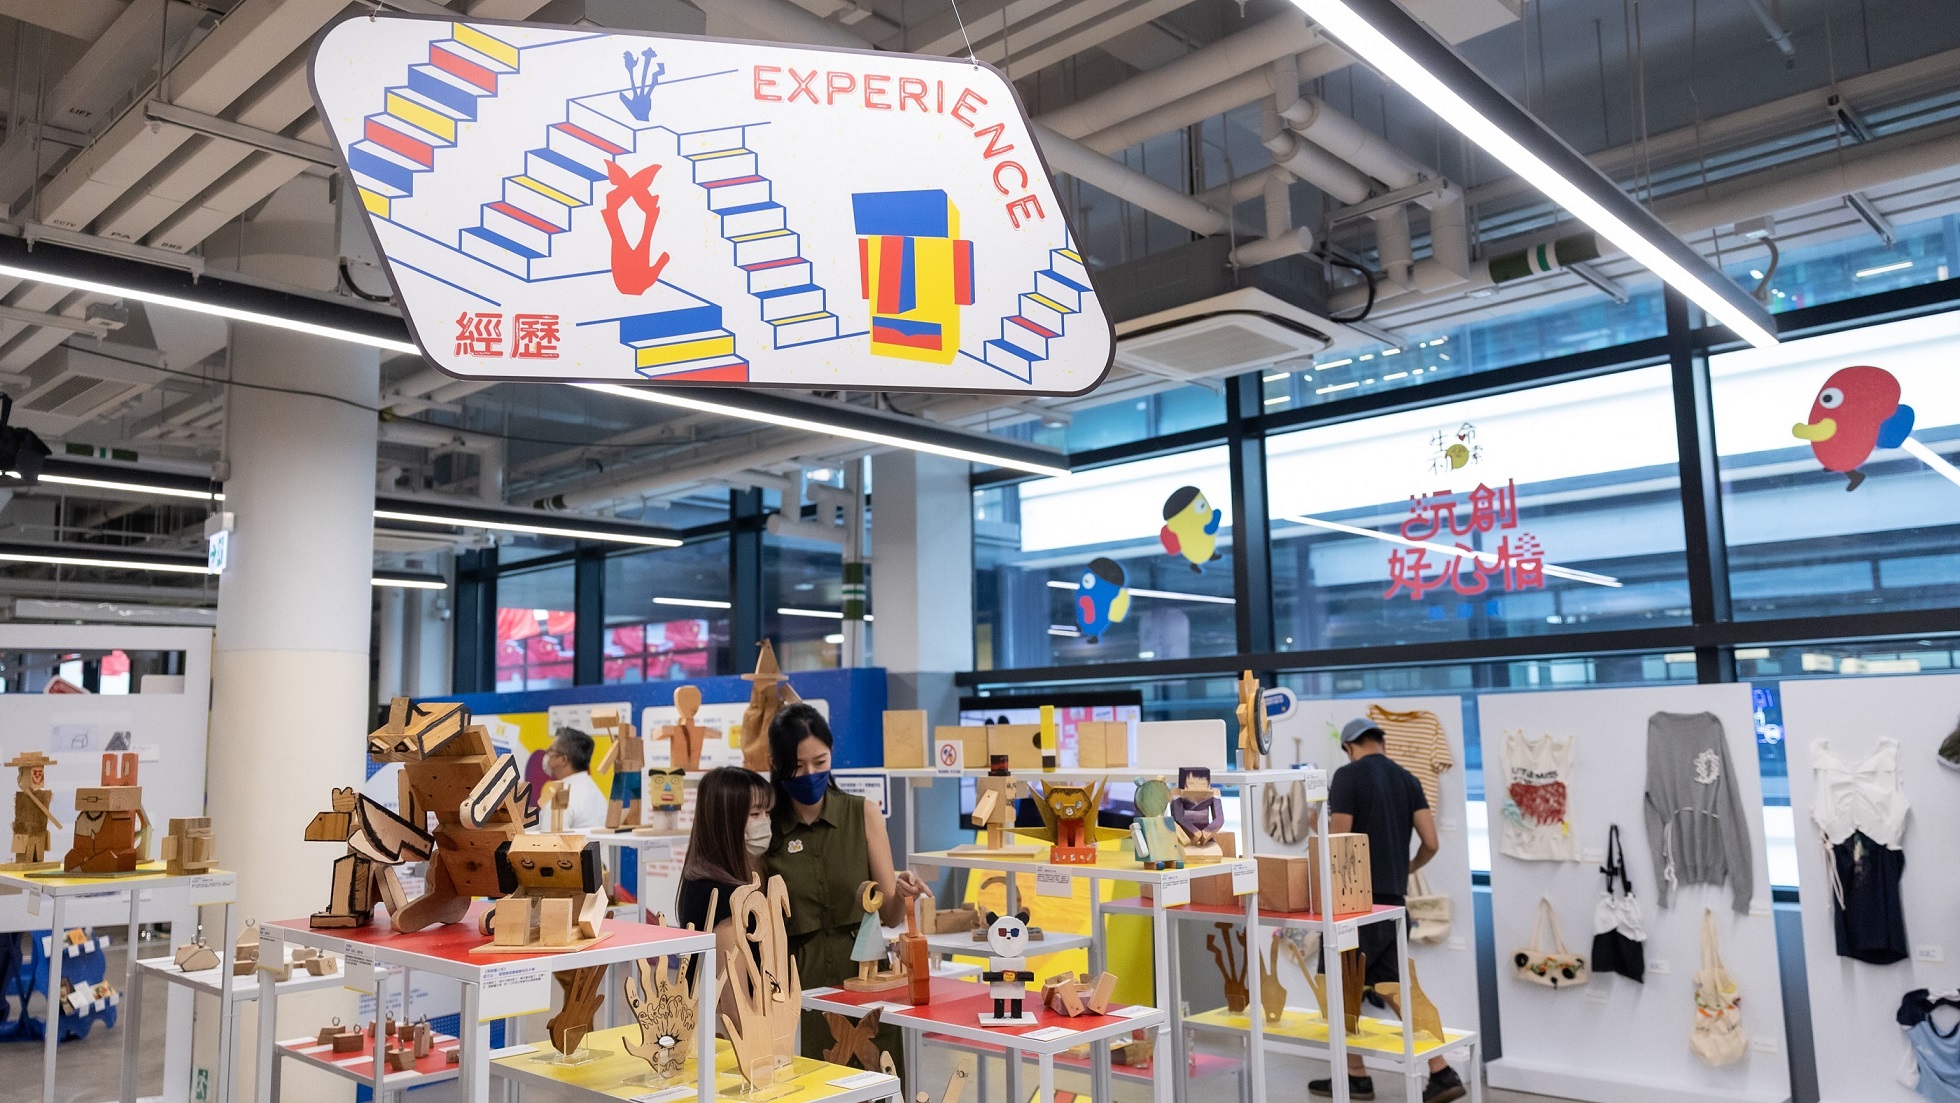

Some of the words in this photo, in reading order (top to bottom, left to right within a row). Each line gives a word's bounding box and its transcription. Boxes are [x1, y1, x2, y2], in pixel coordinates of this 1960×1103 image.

[753, 64, 1046, 231] EXPERIENCE
[454, 311, 561, 359] 經歷
[1384, 533, 1546, 600] 好心情
